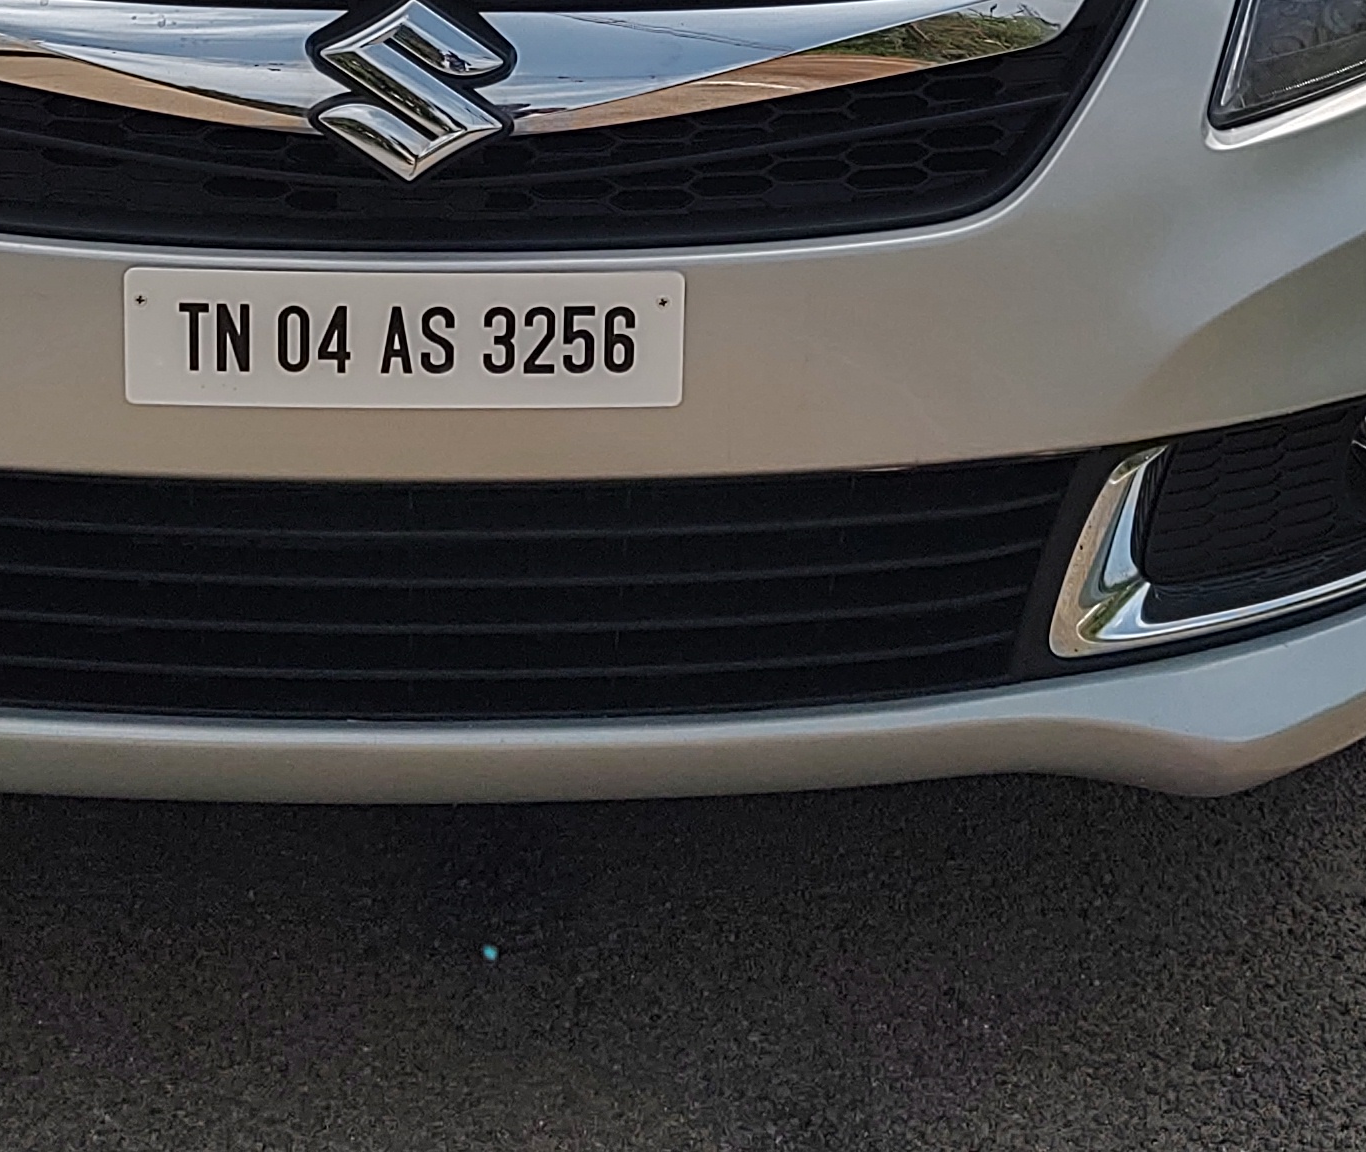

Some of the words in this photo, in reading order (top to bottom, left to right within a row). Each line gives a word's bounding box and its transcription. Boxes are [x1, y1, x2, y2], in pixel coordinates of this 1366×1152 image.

[178, 302, 250, 373] TN
[277, 305, 351, 374] 04
[380, 305, 456, 374] AS
[482, 305, 636, 375] 3256
